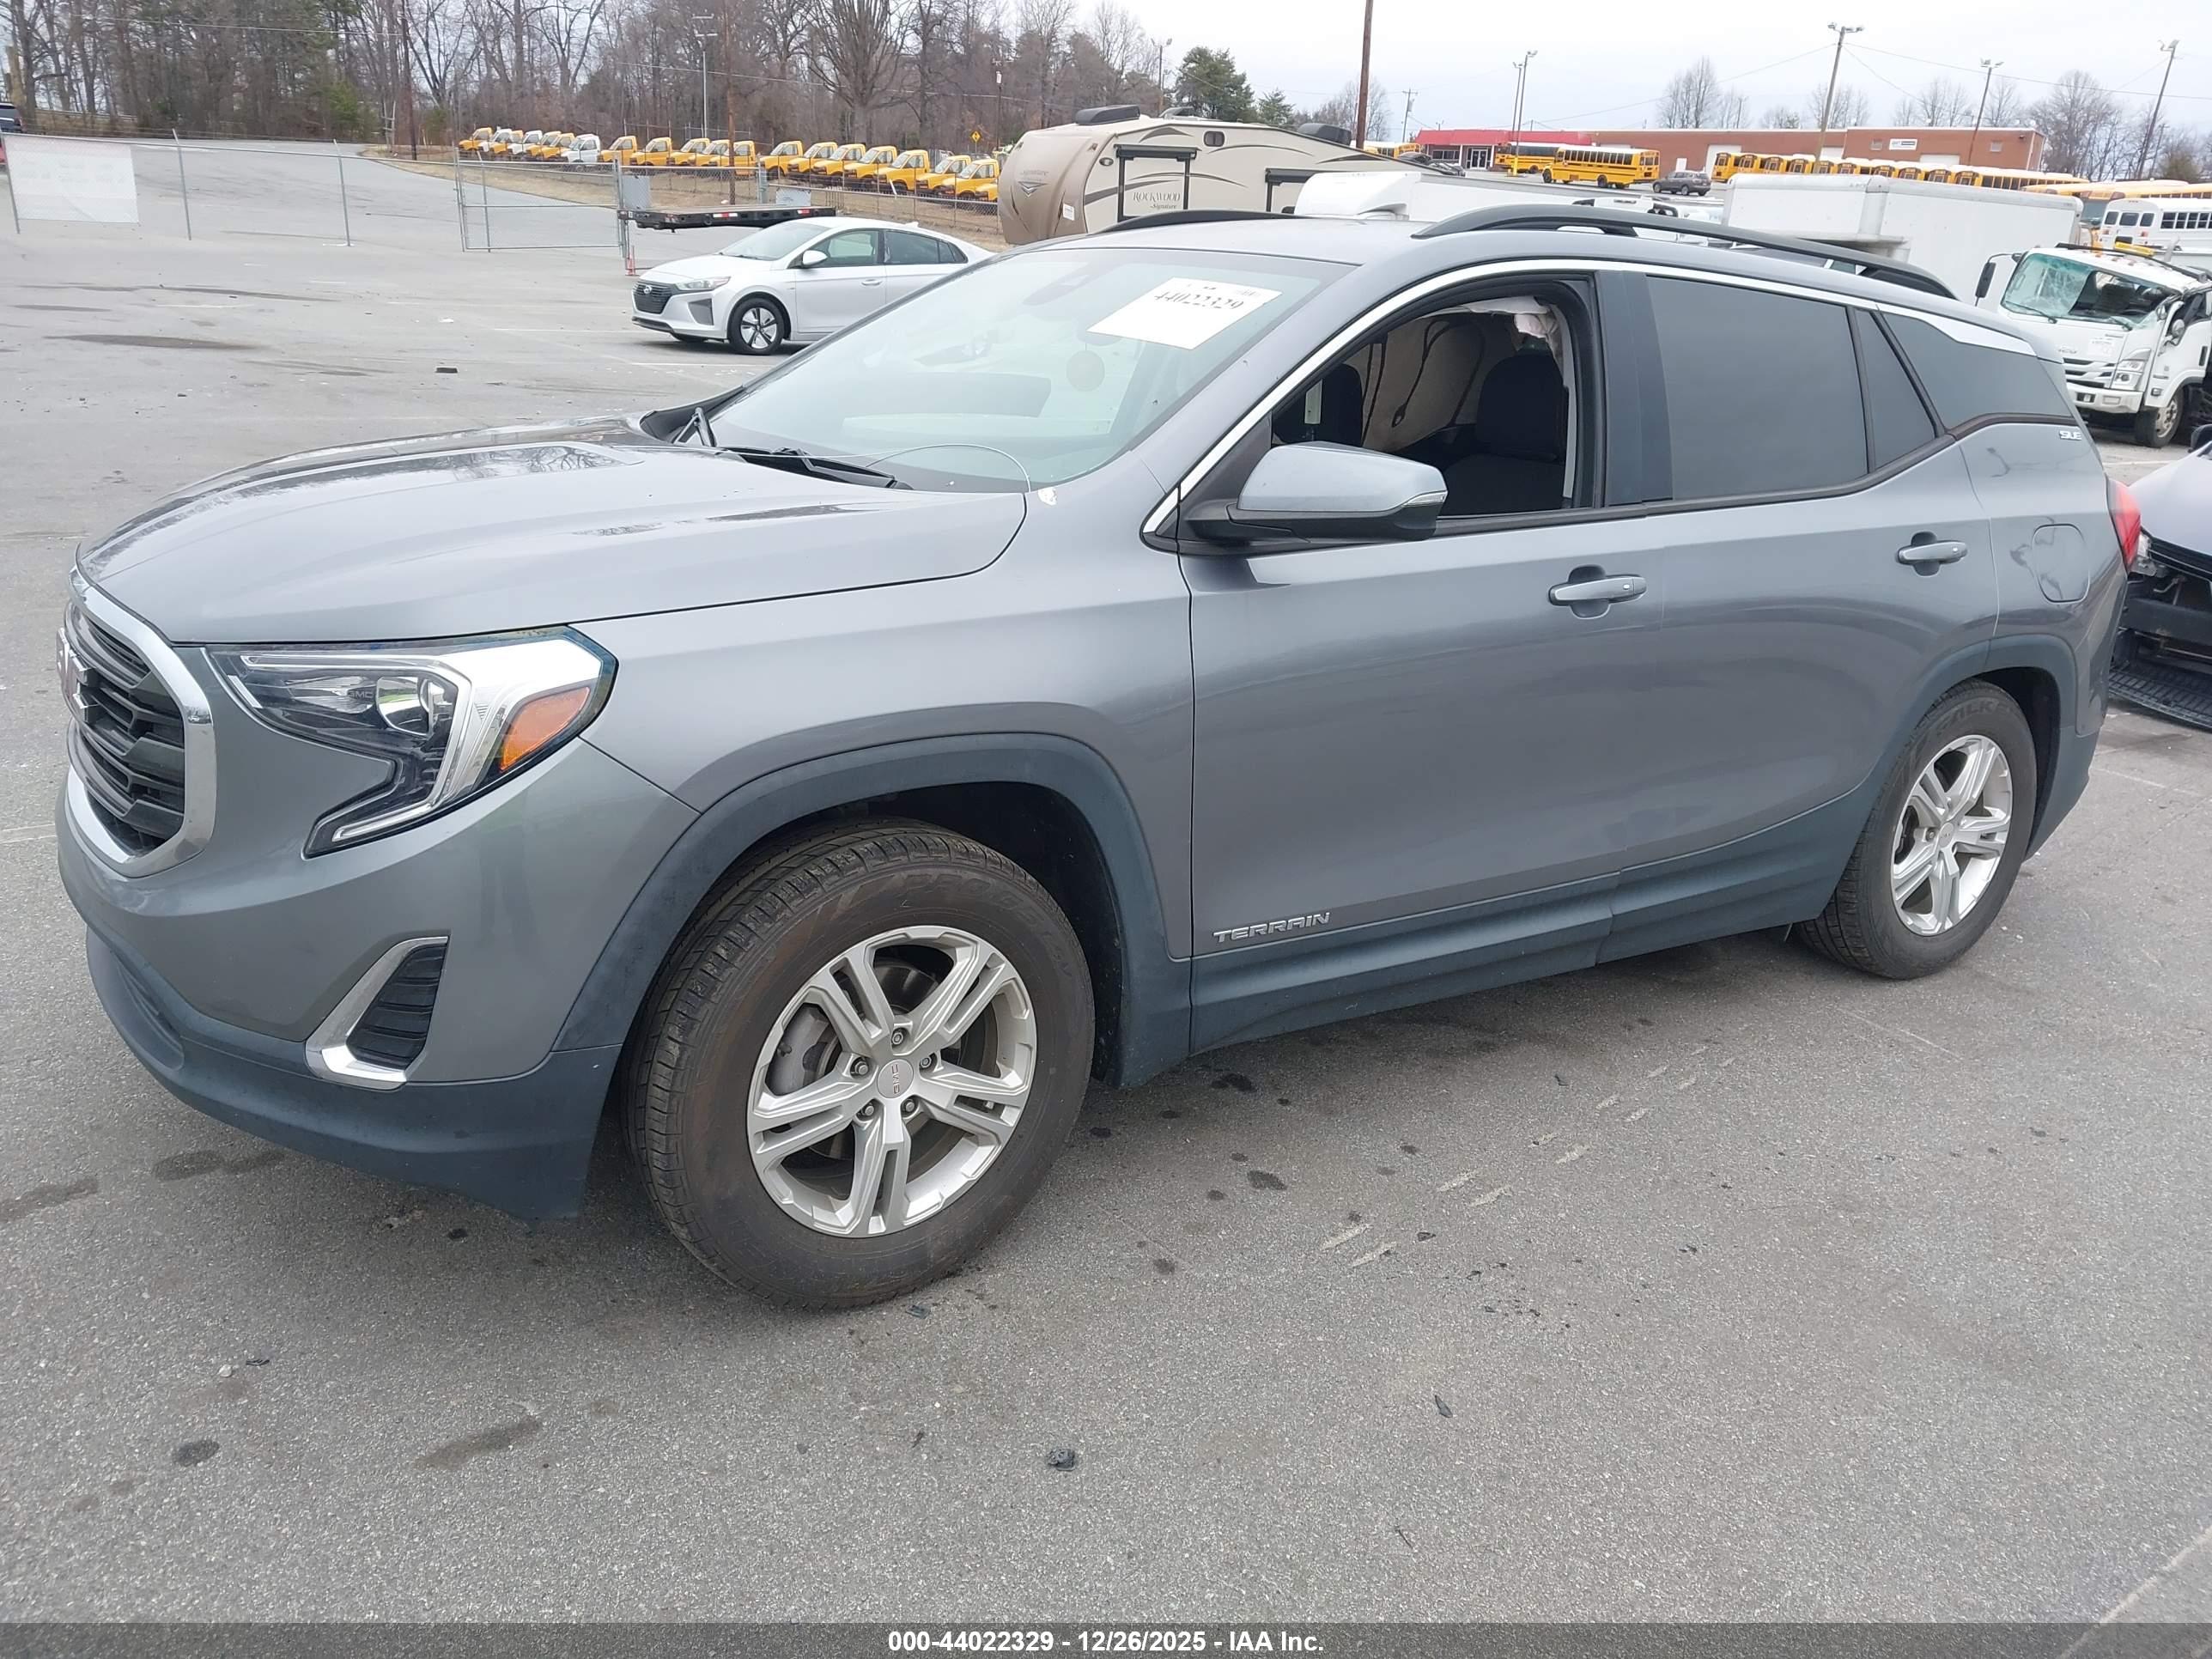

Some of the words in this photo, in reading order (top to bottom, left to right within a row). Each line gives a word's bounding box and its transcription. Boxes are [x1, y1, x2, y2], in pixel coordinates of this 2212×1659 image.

[1133, 191, 1181, 203] ROCKWOOD
[1212, 912, 1330, 943] TERRAIN
[891, 1063, 901, 1095] GMC
